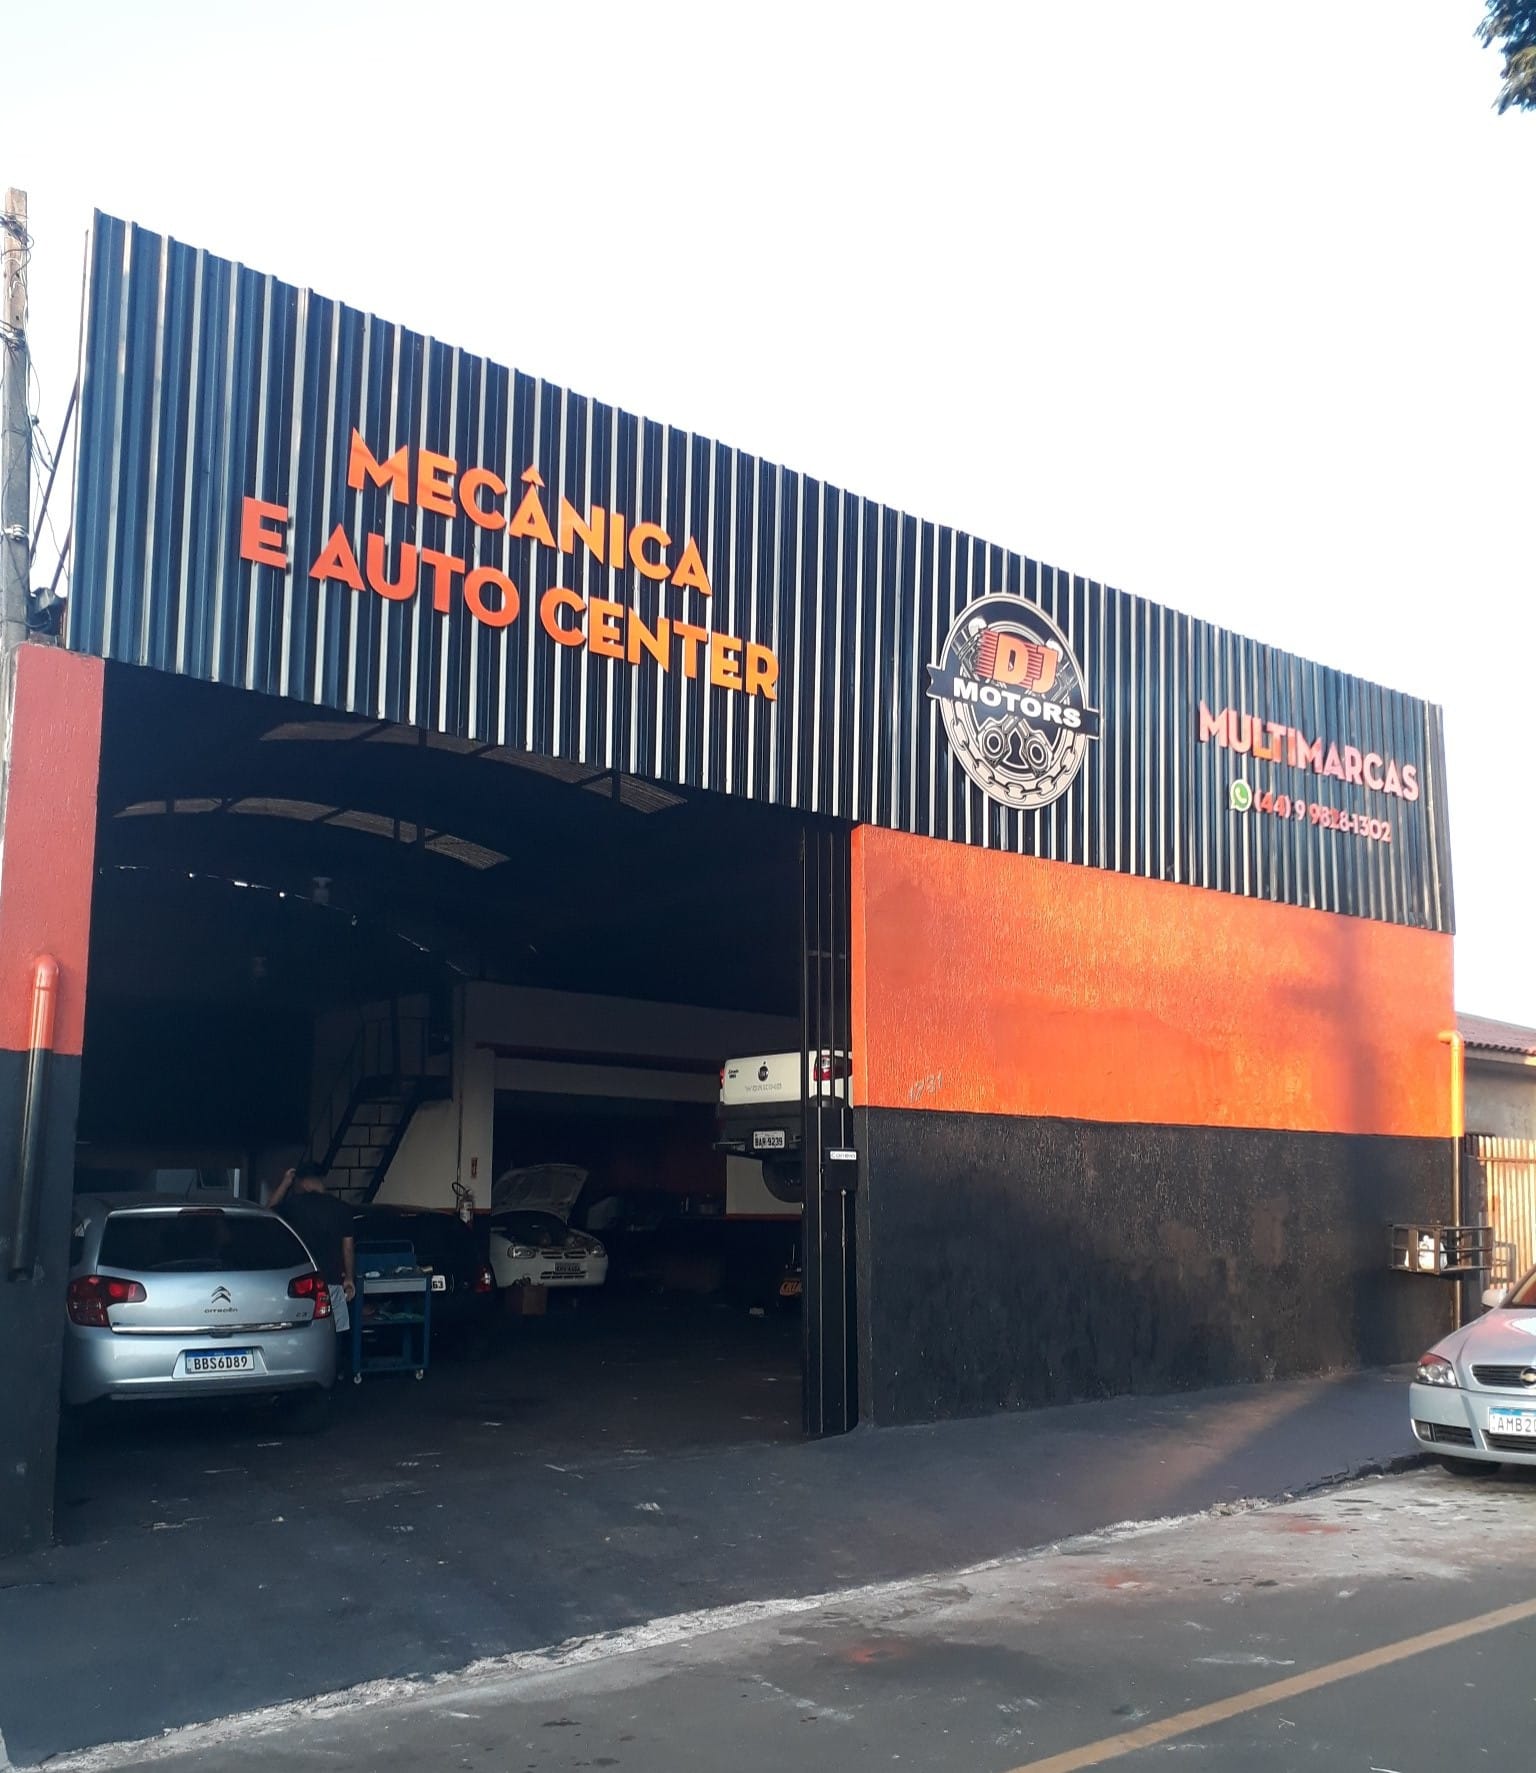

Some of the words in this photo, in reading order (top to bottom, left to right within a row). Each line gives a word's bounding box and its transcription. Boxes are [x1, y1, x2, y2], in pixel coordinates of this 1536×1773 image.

[348, 427, 712, 596] MECÂNICA
[240, 496, 288, 569] E
[309, 524, 521, 629] AUTO
[540, 587, 779, 700] CENTER
[990, 631, 1059, 694] DJ
[952, 676, 1082, 728] MOTORS
[1198, 699, 1420, 802] MULTIMARCAS
[1254, 788, 1292, 819] (44)
[1294, 800, 1306, 821] 9
[1309, 803, 1393, 844] 9828-1302
[193, 1356, 248, 1370] BBS6D89
